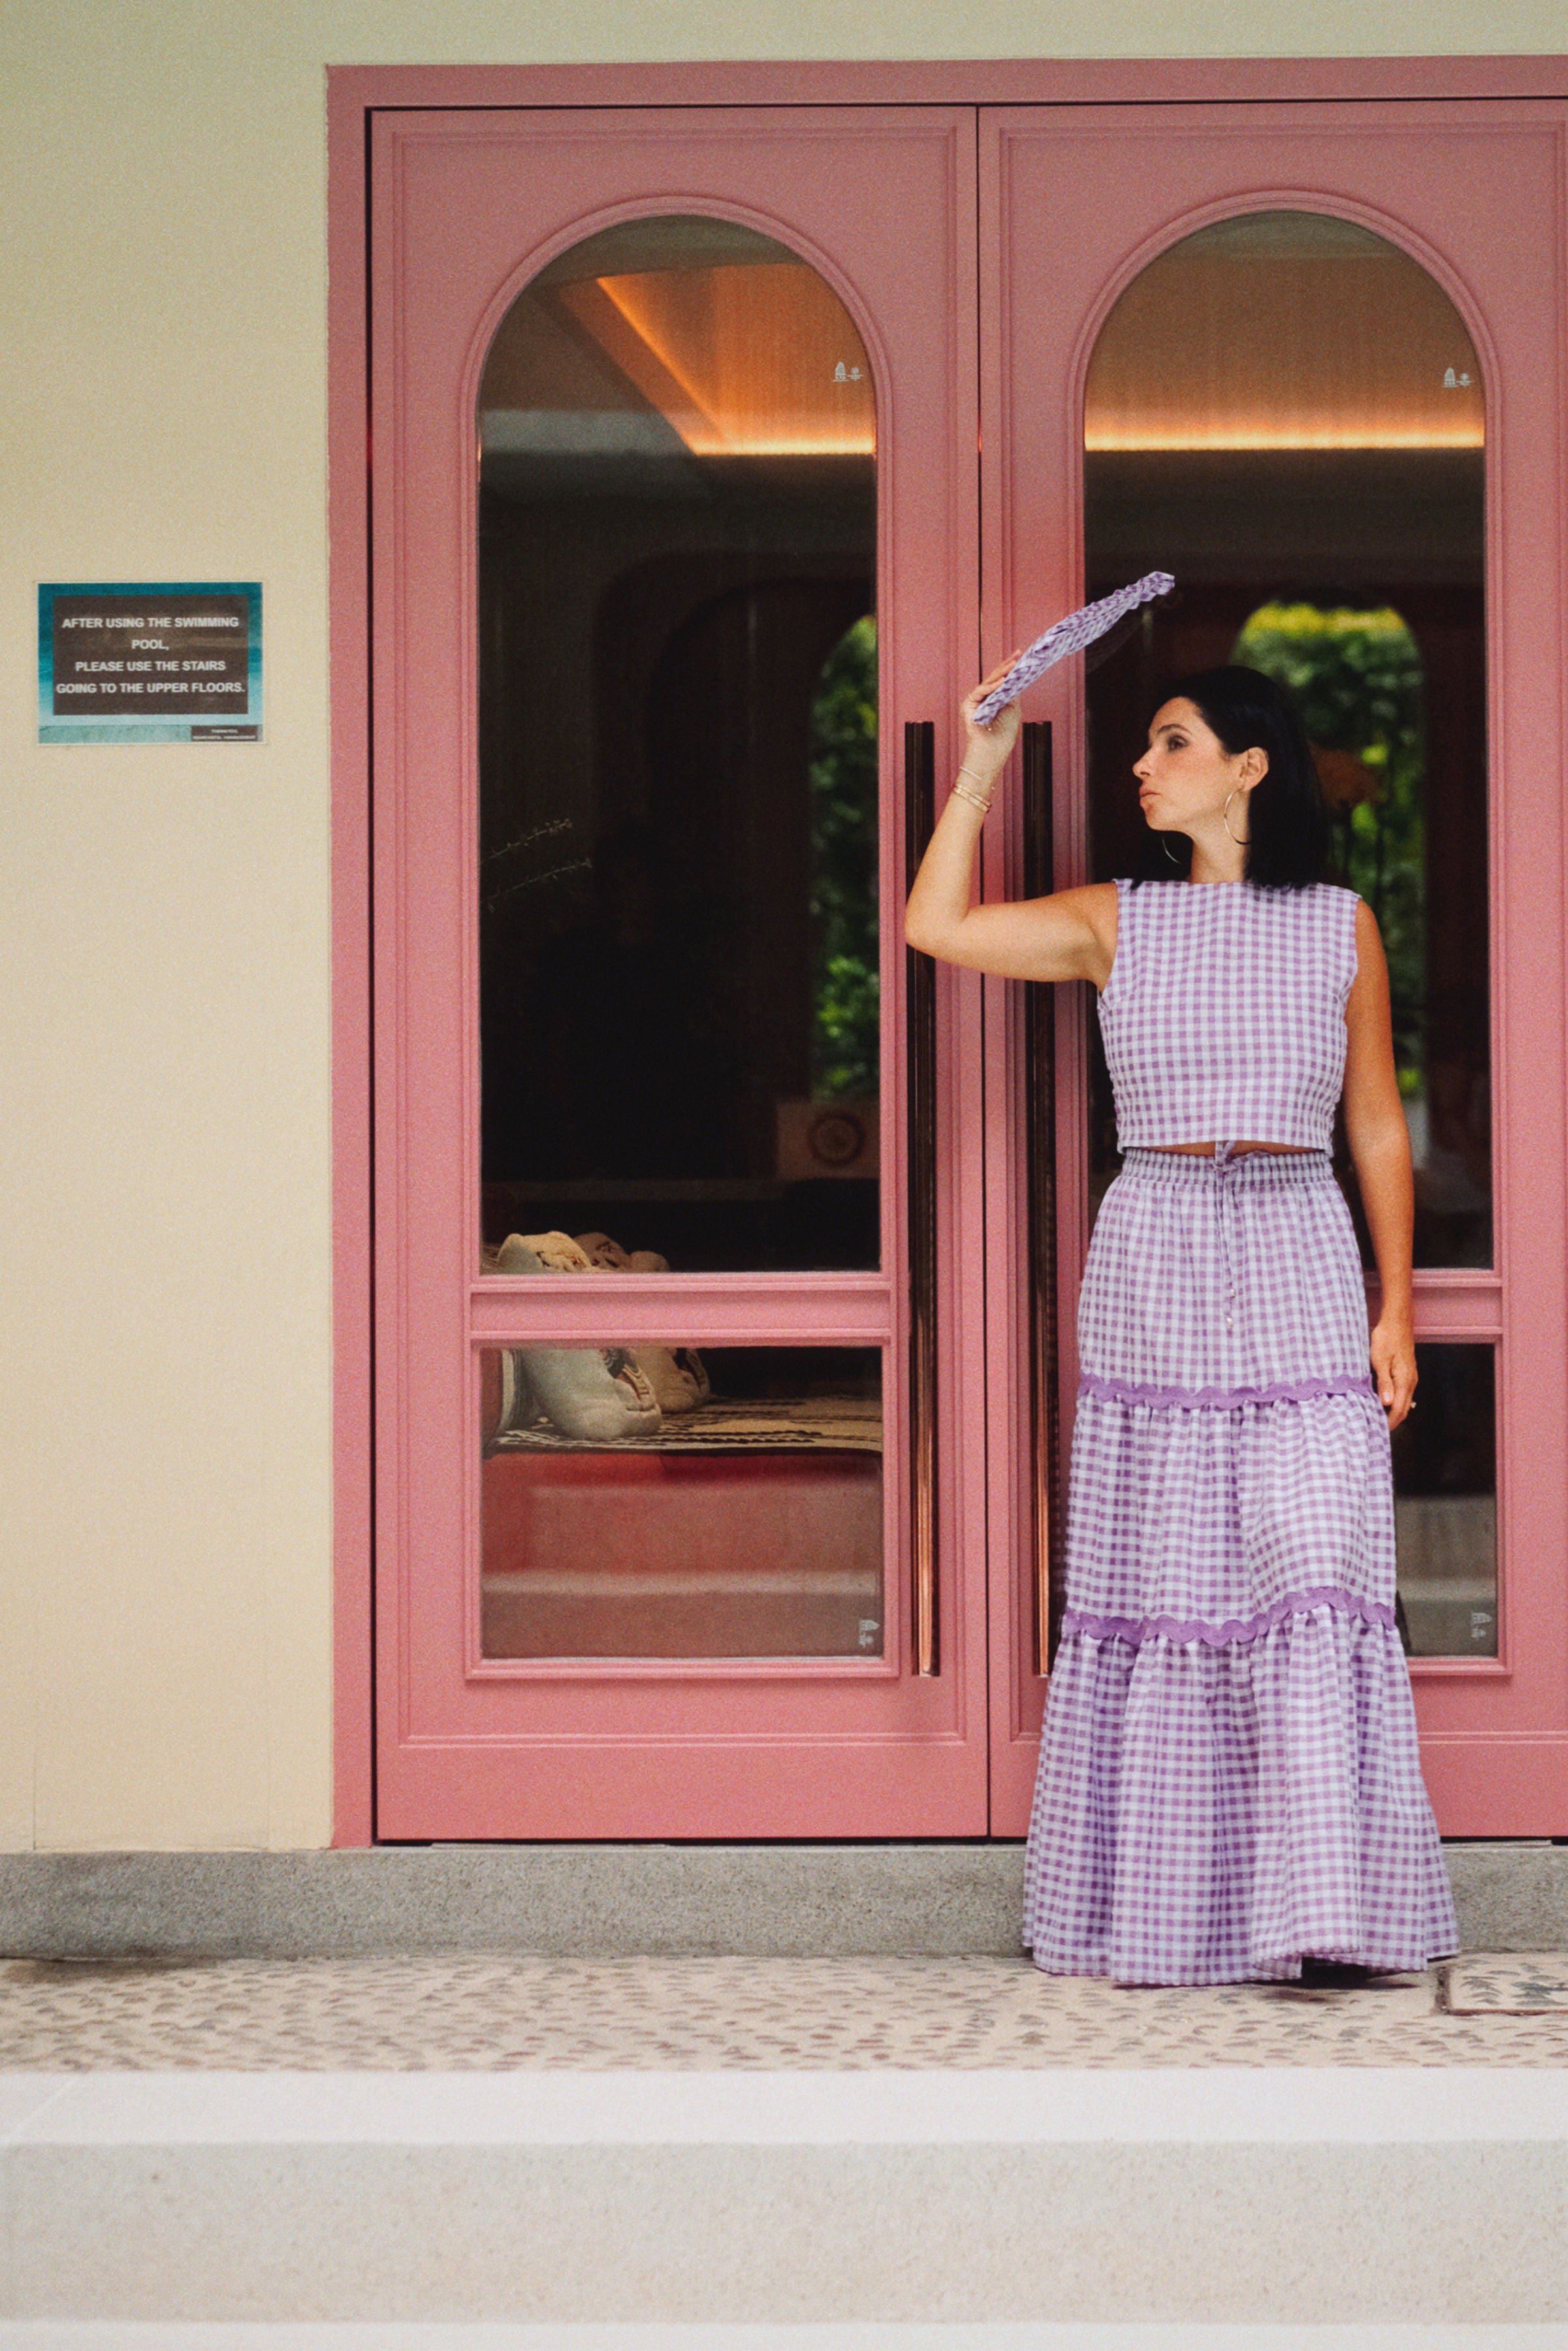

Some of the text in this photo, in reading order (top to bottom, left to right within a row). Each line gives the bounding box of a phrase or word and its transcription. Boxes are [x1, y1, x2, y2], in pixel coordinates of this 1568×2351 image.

[62, 616, 240, 628] AFTER USING THE SWIMMING
[131, 639, 170, 650] POOL,
[75, 660, 226, 672] PLEASE USE THE STAIRS
[56, 682, 245, 694] GOING TO THE UPPER FLOORS.
